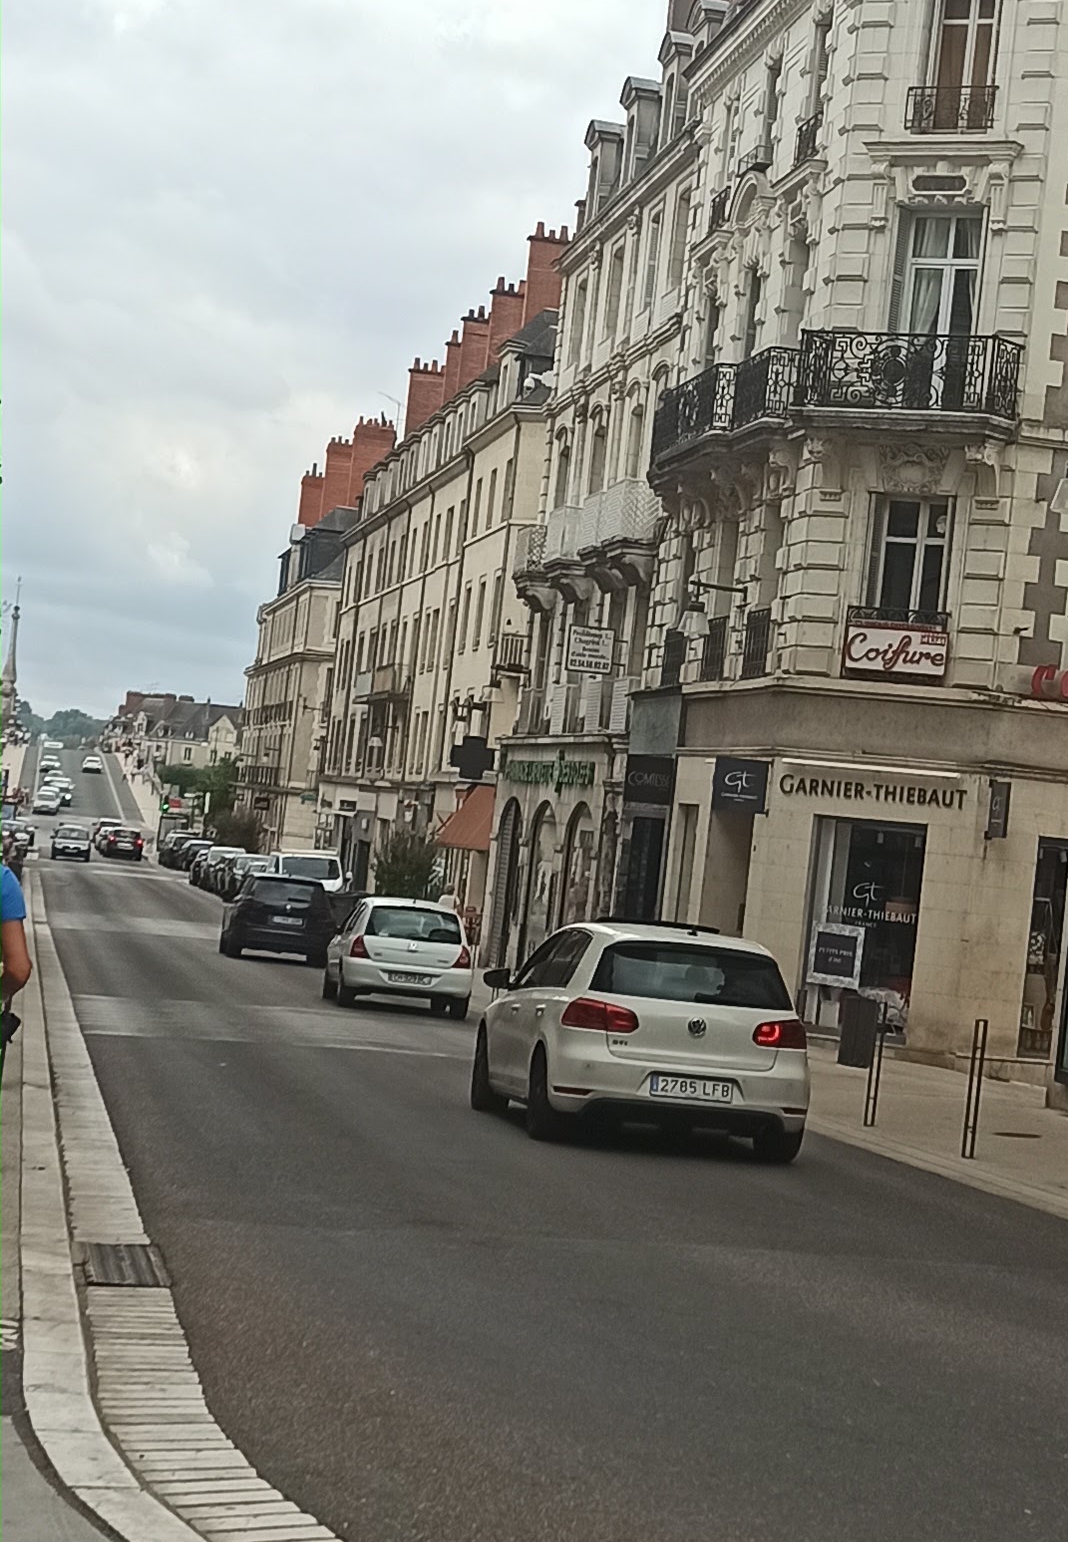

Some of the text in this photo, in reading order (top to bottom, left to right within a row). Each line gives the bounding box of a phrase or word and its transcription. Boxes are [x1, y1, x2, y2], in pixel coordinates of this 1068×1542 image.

[779, 773, 968, 810] GARNIER-THIEBAUT
[828, 904, 917, 925] ARNIER-THIEBAUT
[660, 1078, 730, 1097] 2785 LFB
